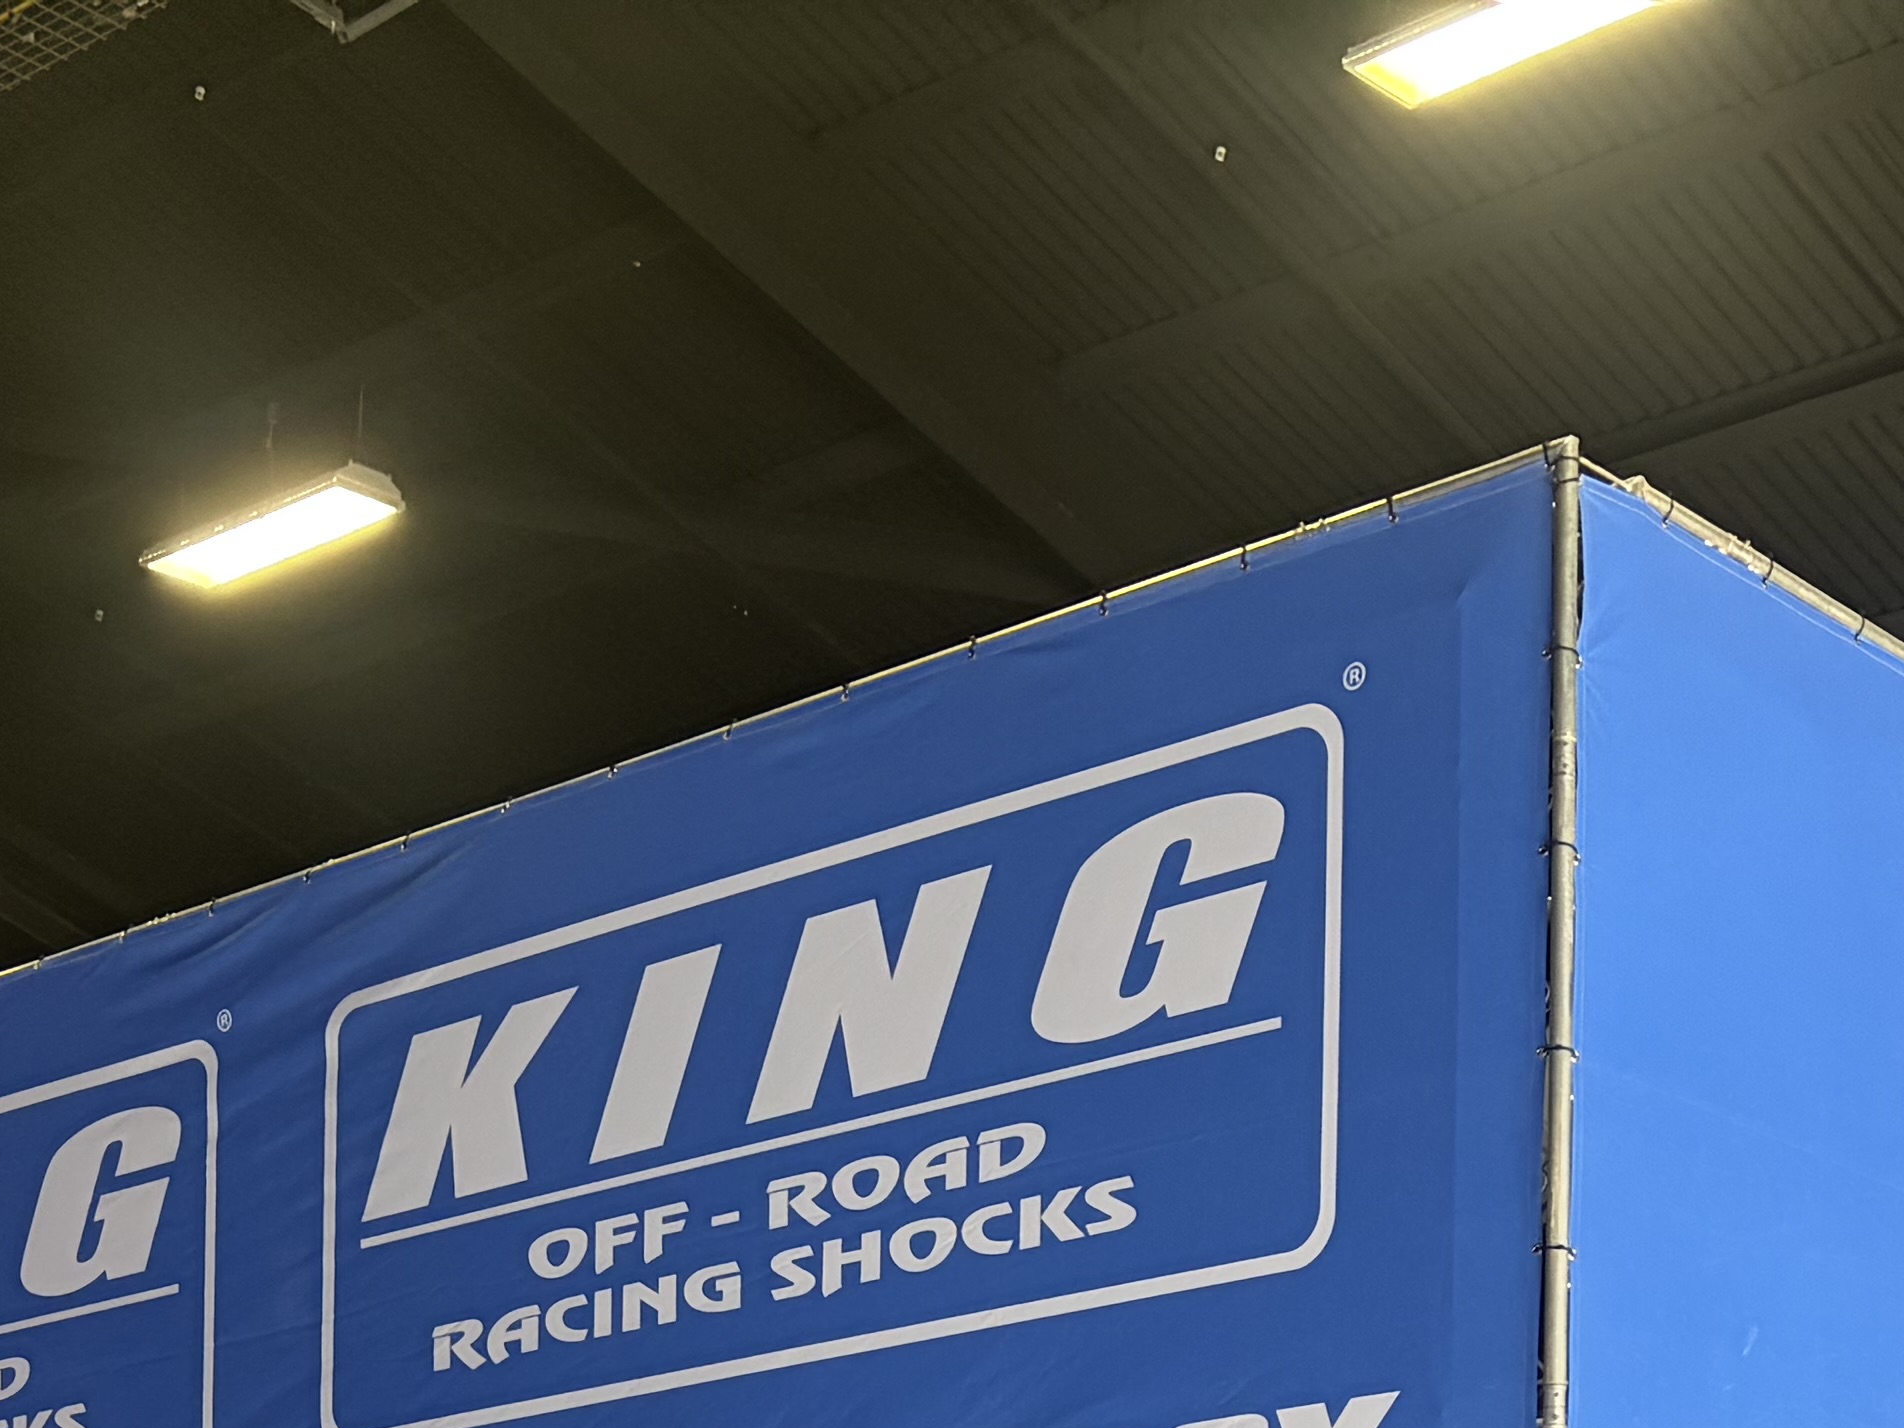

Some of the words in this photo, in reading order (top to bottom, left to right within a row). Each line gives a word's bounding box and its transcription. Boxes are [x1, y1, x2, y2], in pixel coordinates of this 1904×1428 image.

[360, 792, 1285, 1222] KING
[432, 1265, 743, 1373] RACING
[770, 1176, 1137, 1304] SHOCKS
